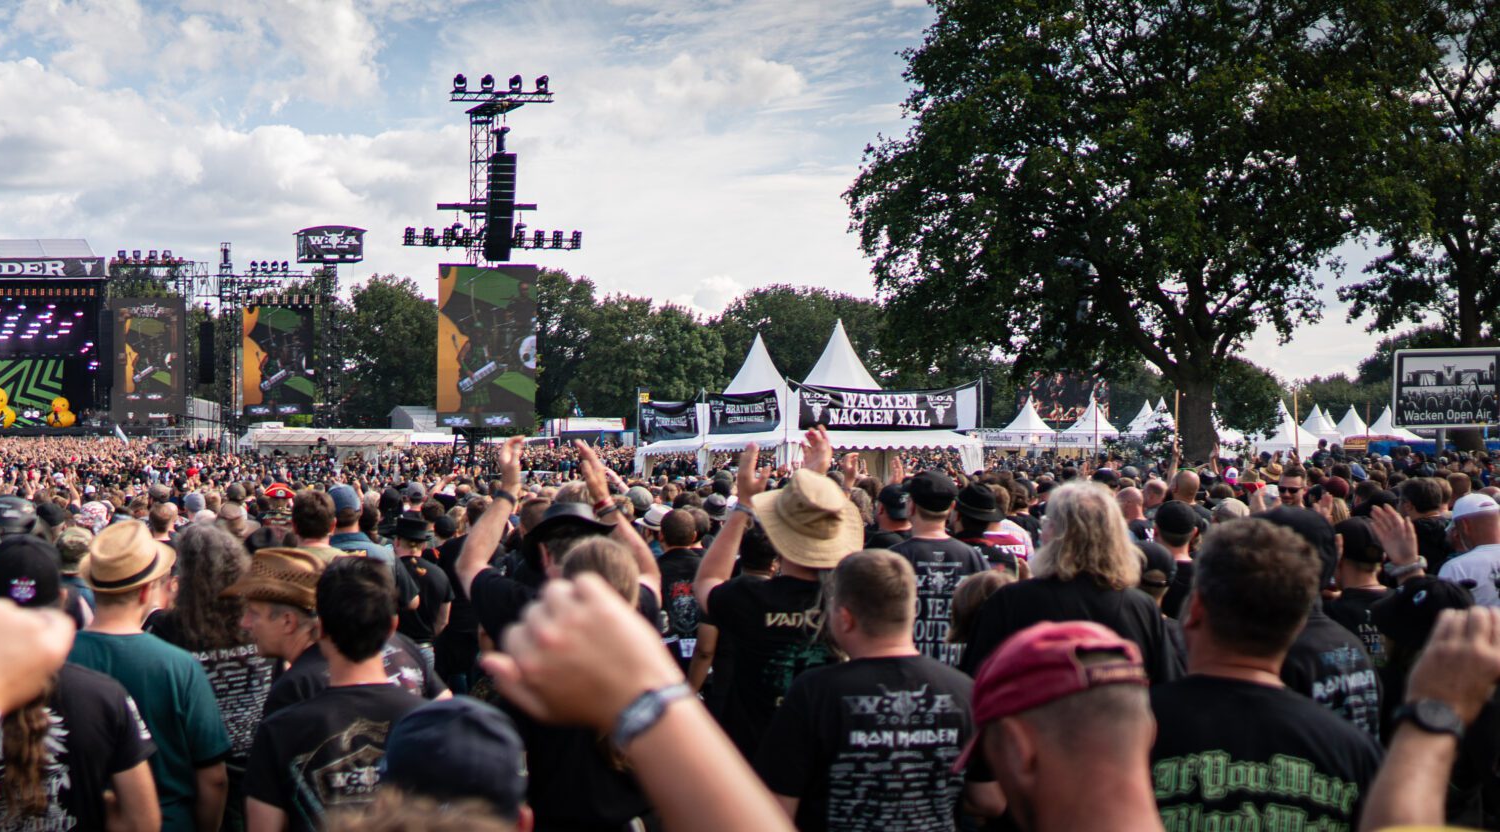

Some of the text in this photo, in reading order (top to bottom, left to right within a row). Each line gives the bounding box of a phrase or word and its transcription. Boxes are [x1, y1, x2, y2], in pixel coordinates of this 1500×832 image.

[726, 402, 766, 414] BRATWURST
[841, 393, 917, 408] WACKEN
[828, 409, 931, 427] NACKEN XXL
[1404, 408, 1491, 423] Wacken Open Air
[850, 728, 959, 748] IRON MAIDEN
[1201, 750, 1268, 799] You
